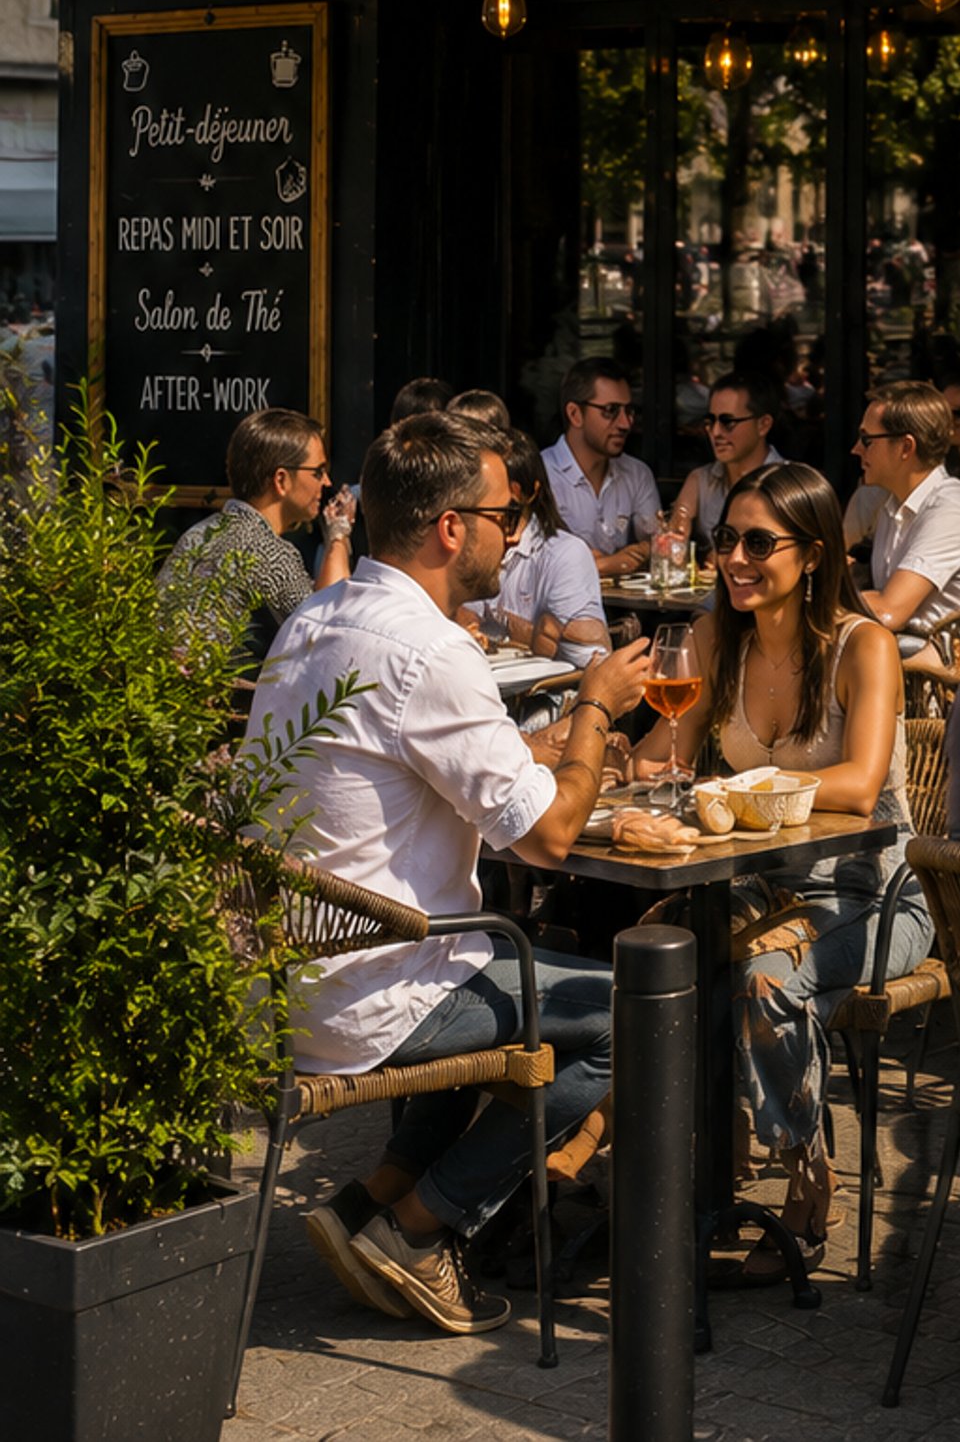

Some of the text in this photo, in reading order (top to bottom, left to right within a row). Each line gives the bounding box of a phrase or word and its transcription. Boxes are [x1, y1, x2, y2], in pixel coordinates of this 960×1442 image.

[129, 104, 293, 163] Petit-déjeuner
[118, 216, 303, 251] REPAS MIDI ET SOIR
[135, 287, 284, 332] Salon de Thé
[139, 375, 270, 412] AFTER-WORK
